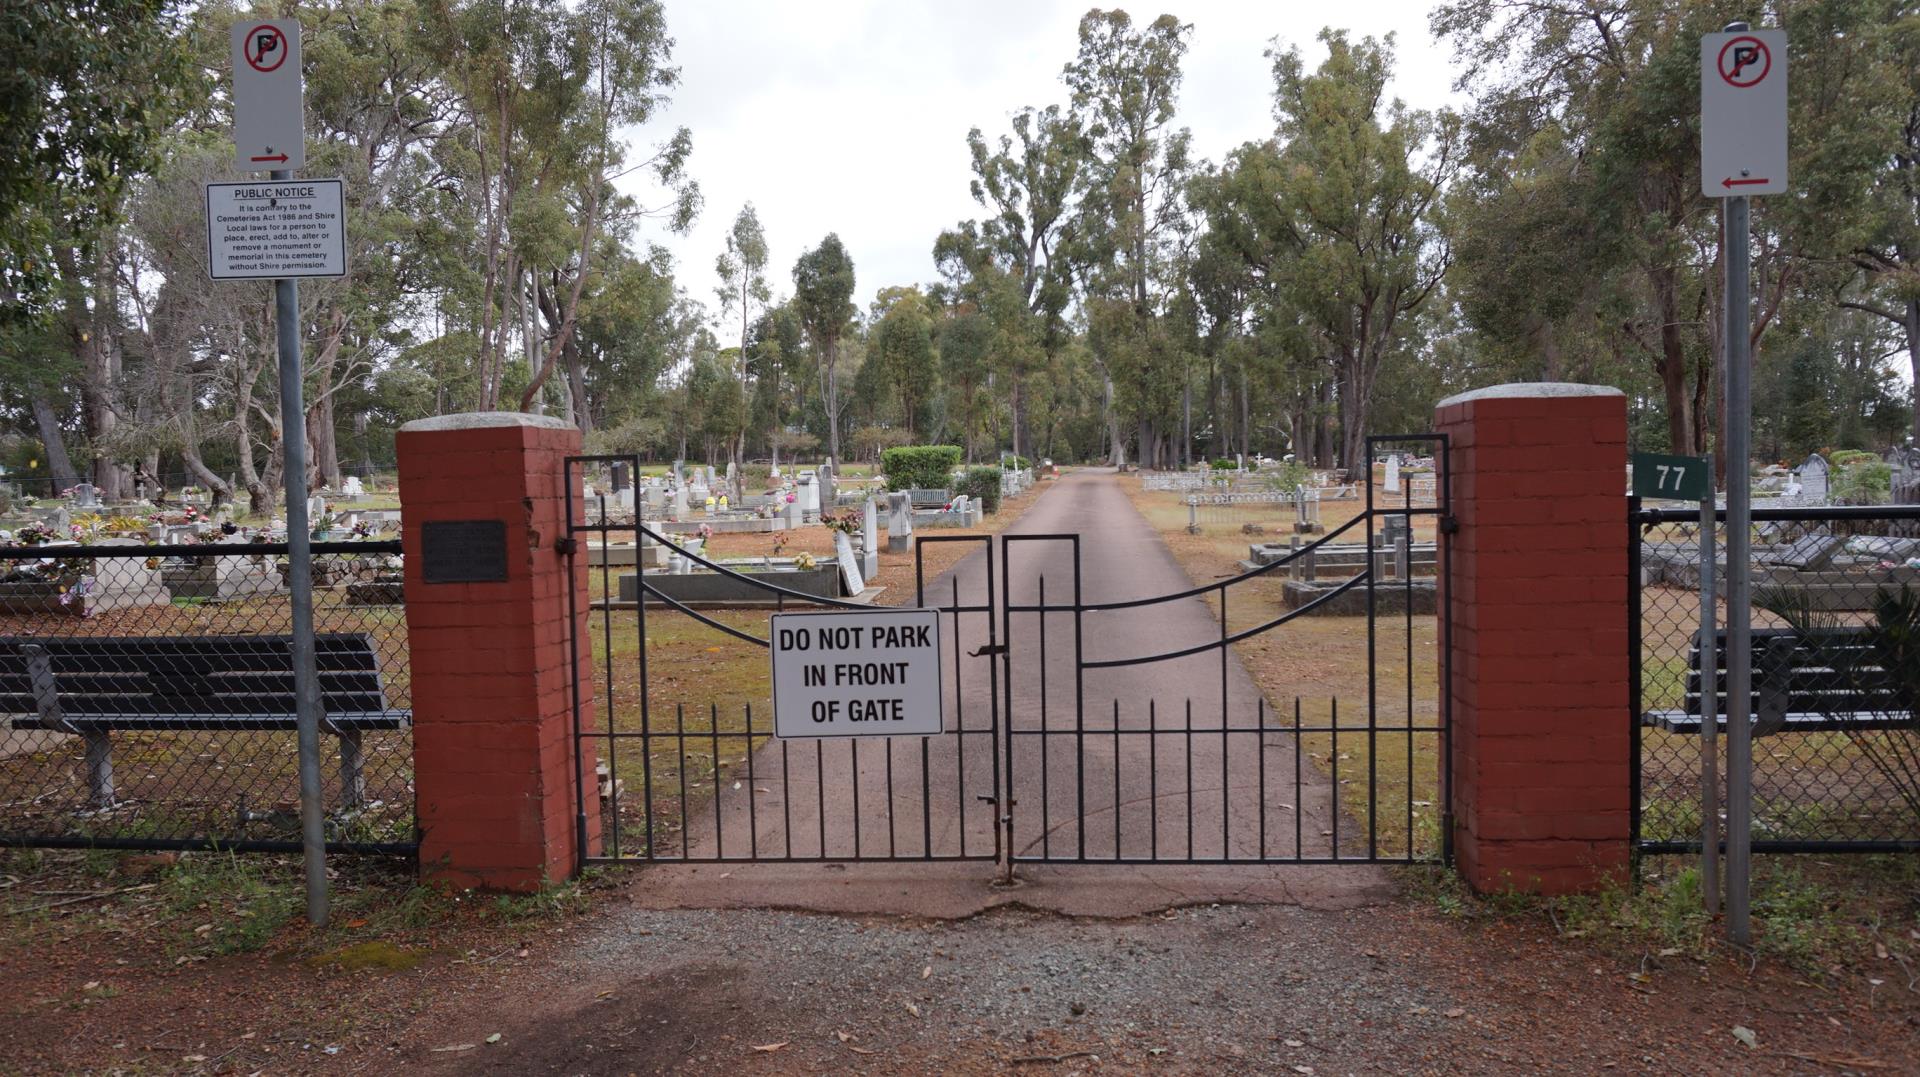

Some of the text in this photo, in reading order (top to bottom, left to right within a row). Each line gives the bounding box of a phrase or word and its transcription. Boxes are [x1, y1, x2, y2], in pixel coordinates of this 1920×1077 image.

[234, 187, 315, 198] PUBLIC NOTICE
[216, 214, 261, 222] Cemeteries
[298, 212, 313, 220] and
[314, 212, 336, 220] Shire
[226, 223, 248, 232] Local
[289, 223, 316, 231] person
[301, 232, 319, 240] alter
[227, 253, 264, 261] memorial
[265, 252, 274, 260] in
[291, 252, 327, 260] cemetery
[259, 262, 280, 270] Shire
[281, 261, 328, 271] permission.
[1656, 464, 1686, 491] 77
[780, 624, 931, 652] DO NOT PARK
[804, 662, 909, 687] IN FRONT
[811, 698, 904, 723] OF GATE
